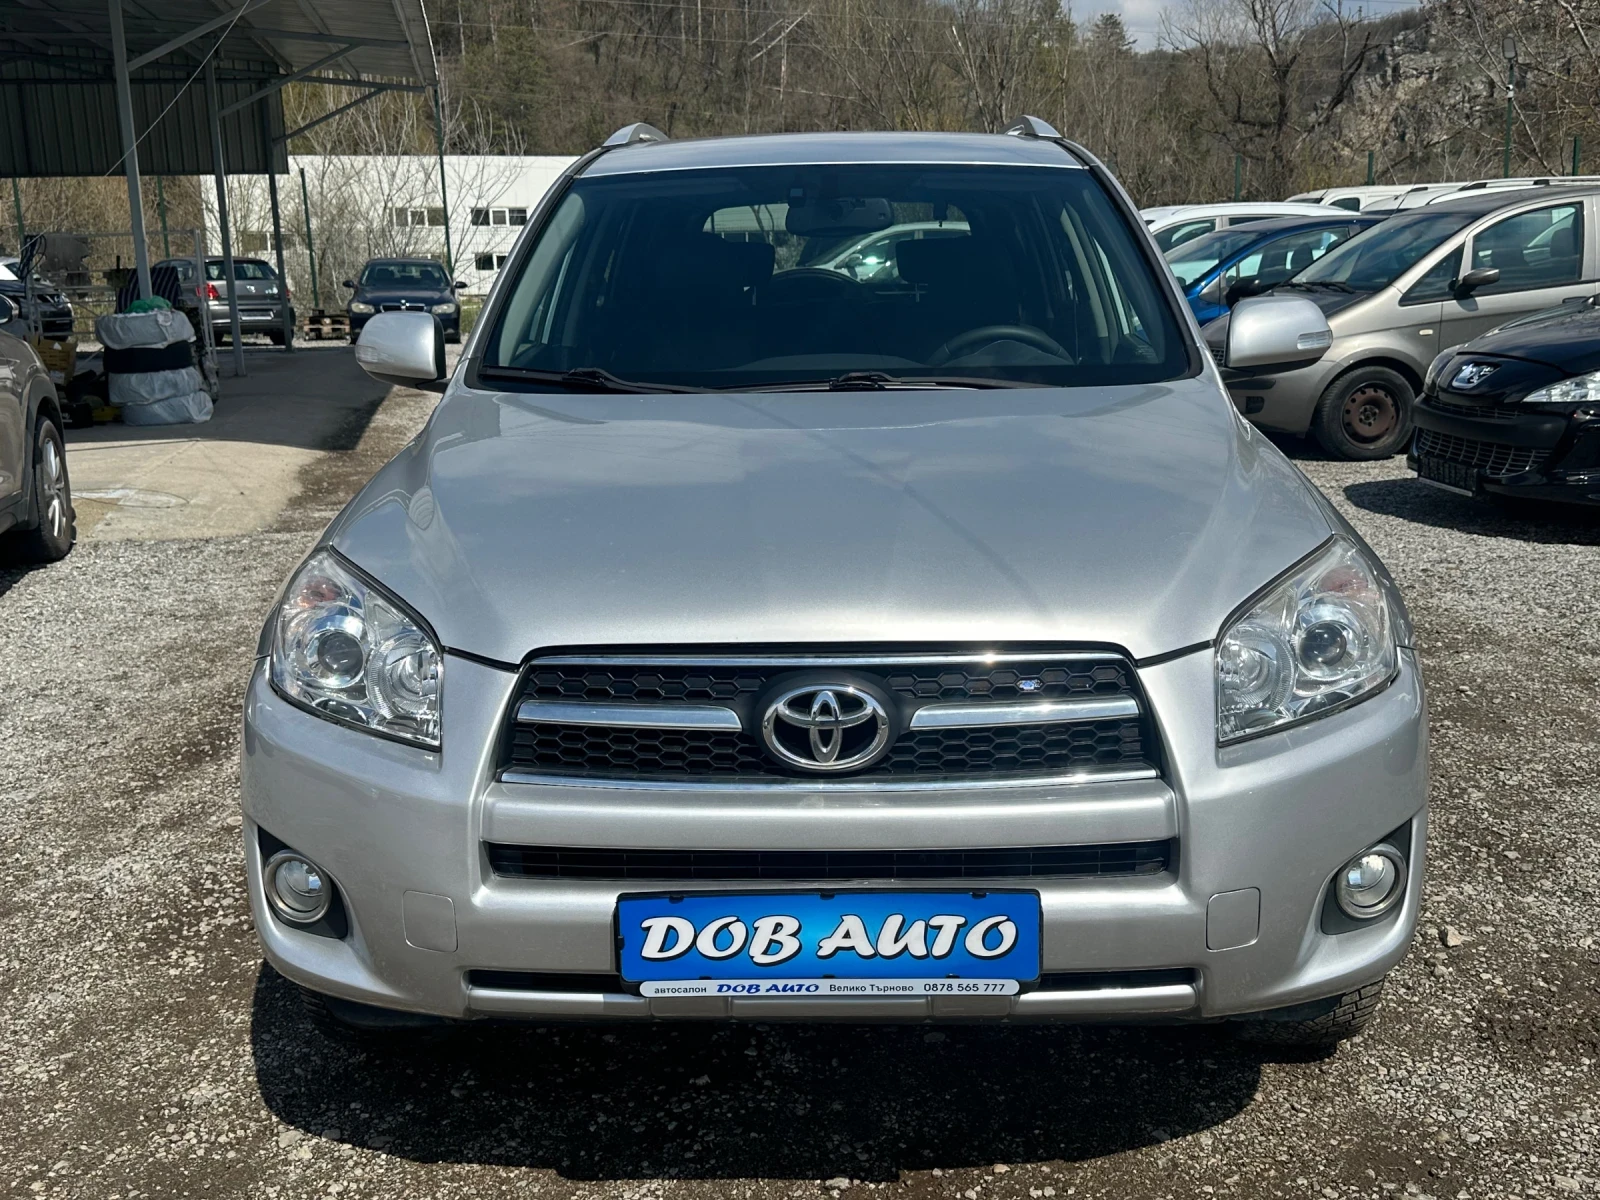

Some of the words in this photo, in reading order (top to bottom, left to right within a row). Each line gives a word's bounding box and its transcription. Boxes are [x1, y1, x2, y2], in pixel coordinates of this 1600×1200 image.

[640, 915, 802, 966] DOB
[817, 914, 1019, 959] AUTO
[654, 986, 707, 994] автосалон
[716, 984, 761, 994] DOB
[765, 983, 820, 994] AUTO
[829, 984, 867, 992] Велико
[869, 984, 914, 993] Търново
[923, 983, 954, 992] 0878
[957, 983, 979, 992] 565
[983, 983, 1006, 992] 777
